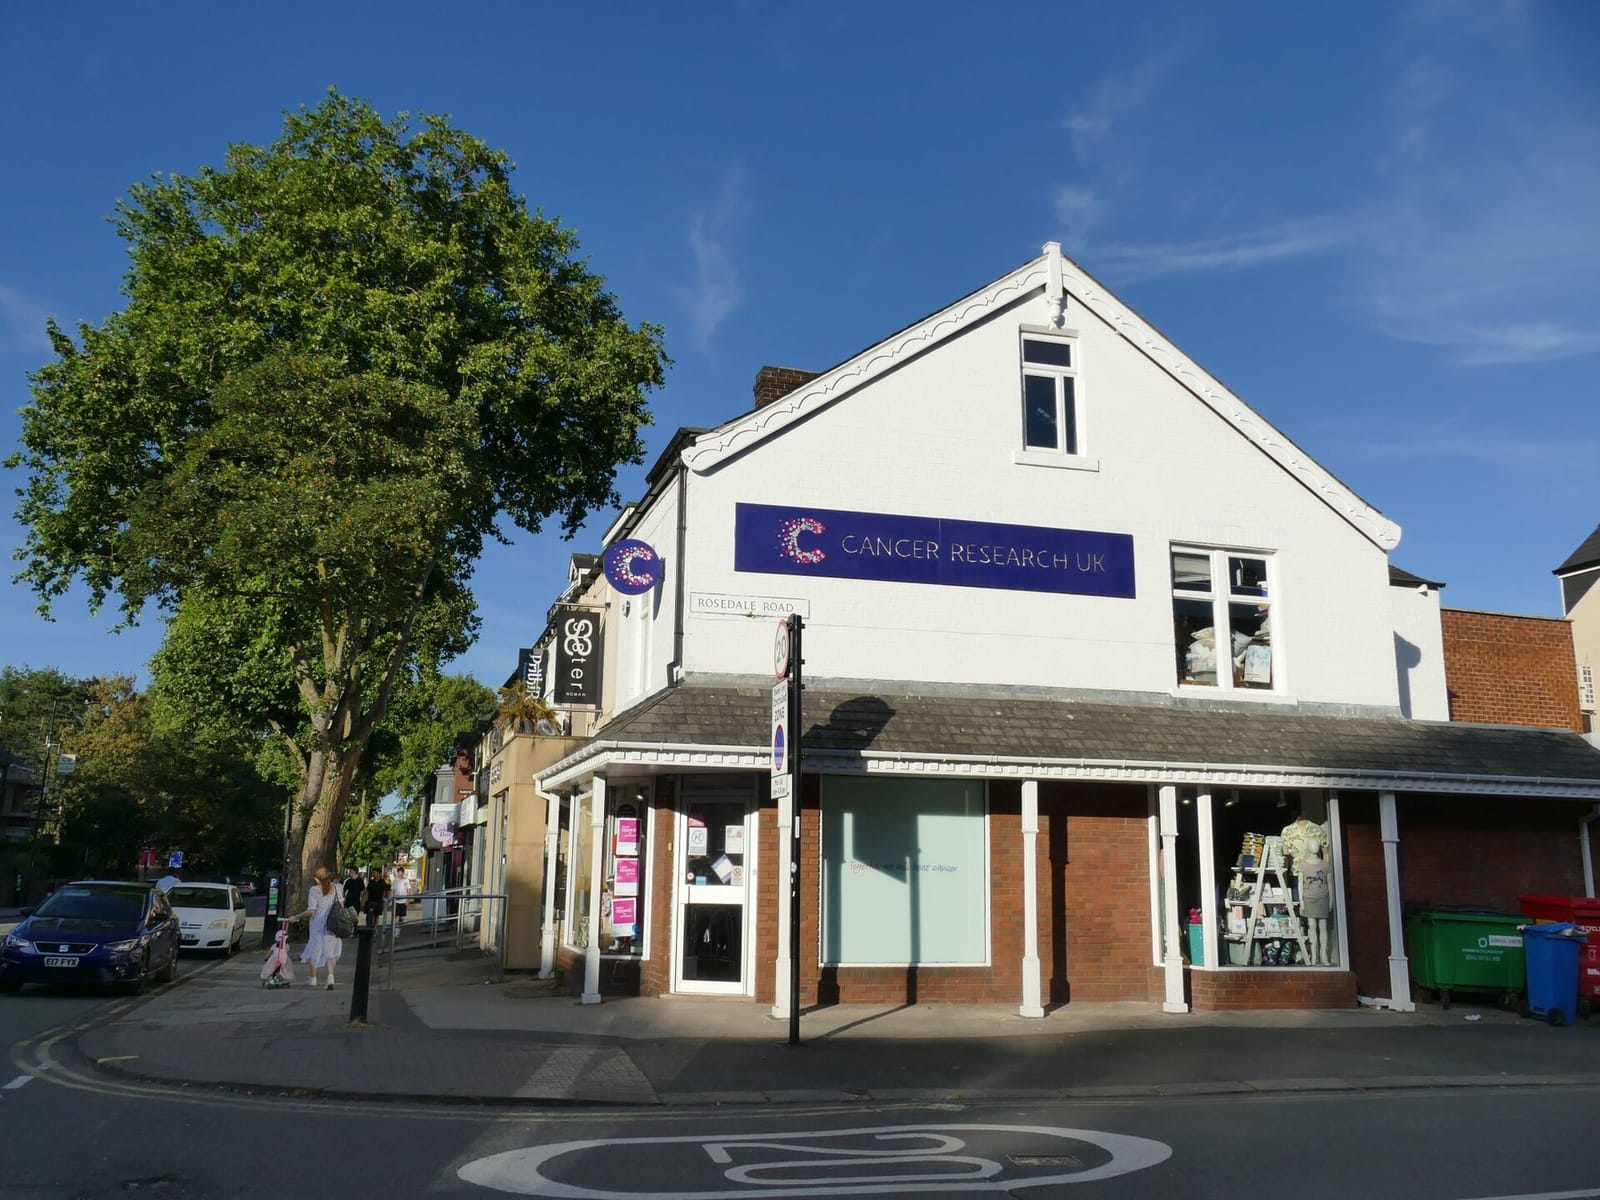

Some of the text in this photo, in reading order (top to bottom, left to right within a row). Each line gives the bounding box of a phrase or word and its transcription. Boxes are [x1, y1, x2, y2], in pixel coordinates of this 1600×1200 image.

[841, 535, 1106, 573] CANCER RESEARCH UK
[697, 597, 757, 611] ROSEDALE
[763, 601, 795, 613] ROAD
[776, 634, 787, 665] 20
[701, 1132, 1004, 1185] 20
